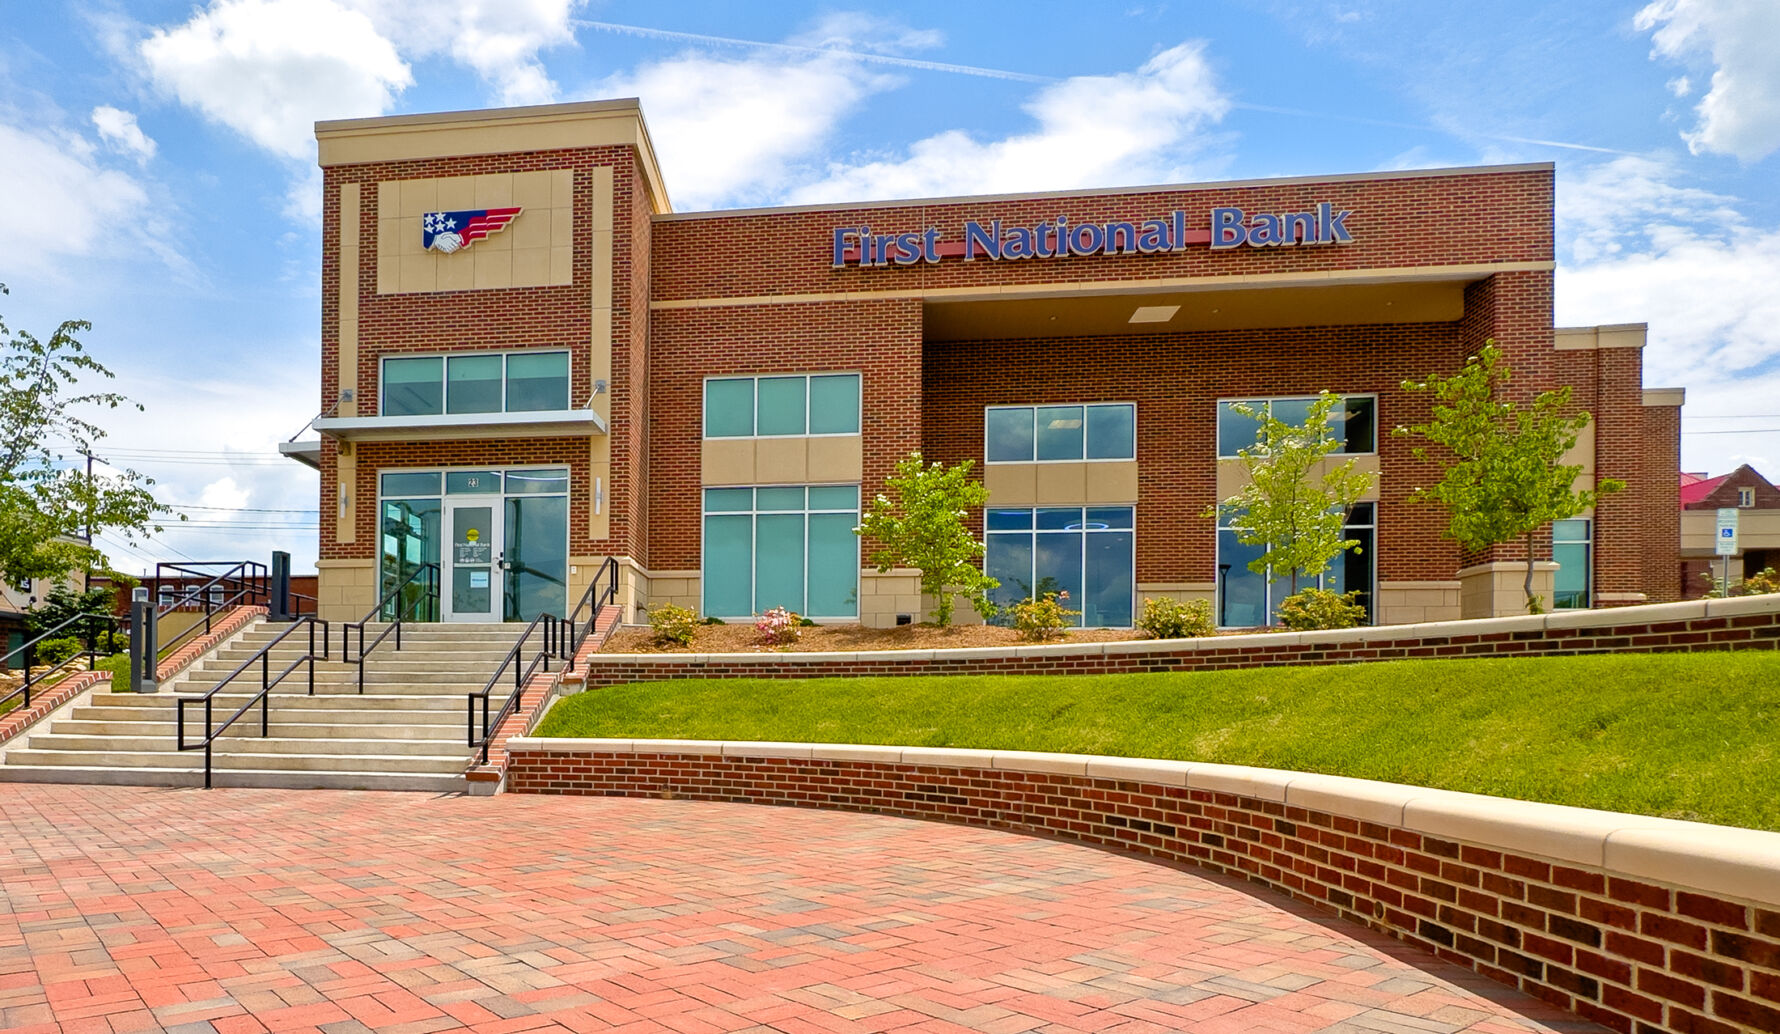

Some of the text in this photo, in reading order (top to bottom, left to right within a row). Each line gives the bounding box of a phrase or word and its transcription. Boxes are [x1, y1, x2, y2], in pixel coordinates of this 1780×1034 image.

[832, 202, 1355, 268] First National Bank
[468, 478, 479, 487] 23
